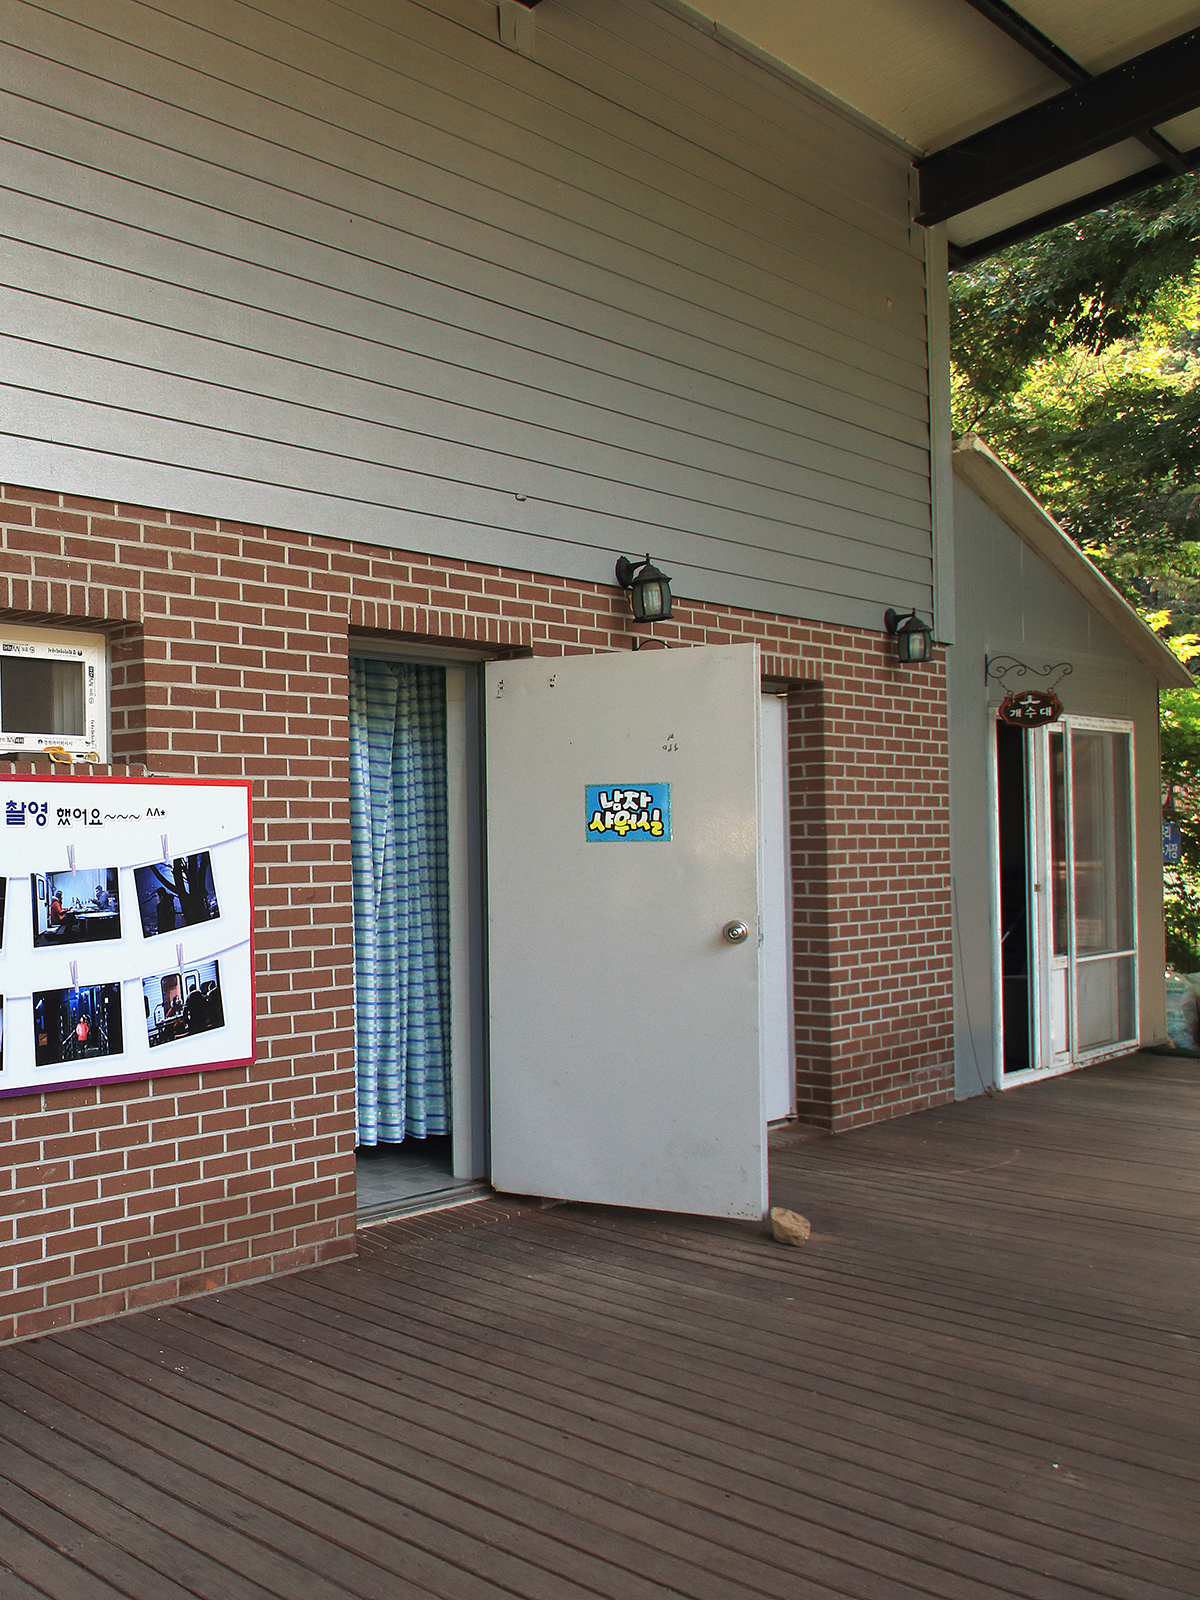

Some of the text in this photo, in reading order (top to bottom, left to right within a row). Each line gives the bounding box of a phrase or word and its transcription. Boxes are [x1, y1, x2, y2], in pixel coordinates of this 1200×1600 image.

[1009, 705, 1053, 719] 개수대
[4, 799, 49, 827] 촬영
[598, 788, 654, 812] 남자
[588, 807, 665, 837] 샤워실
